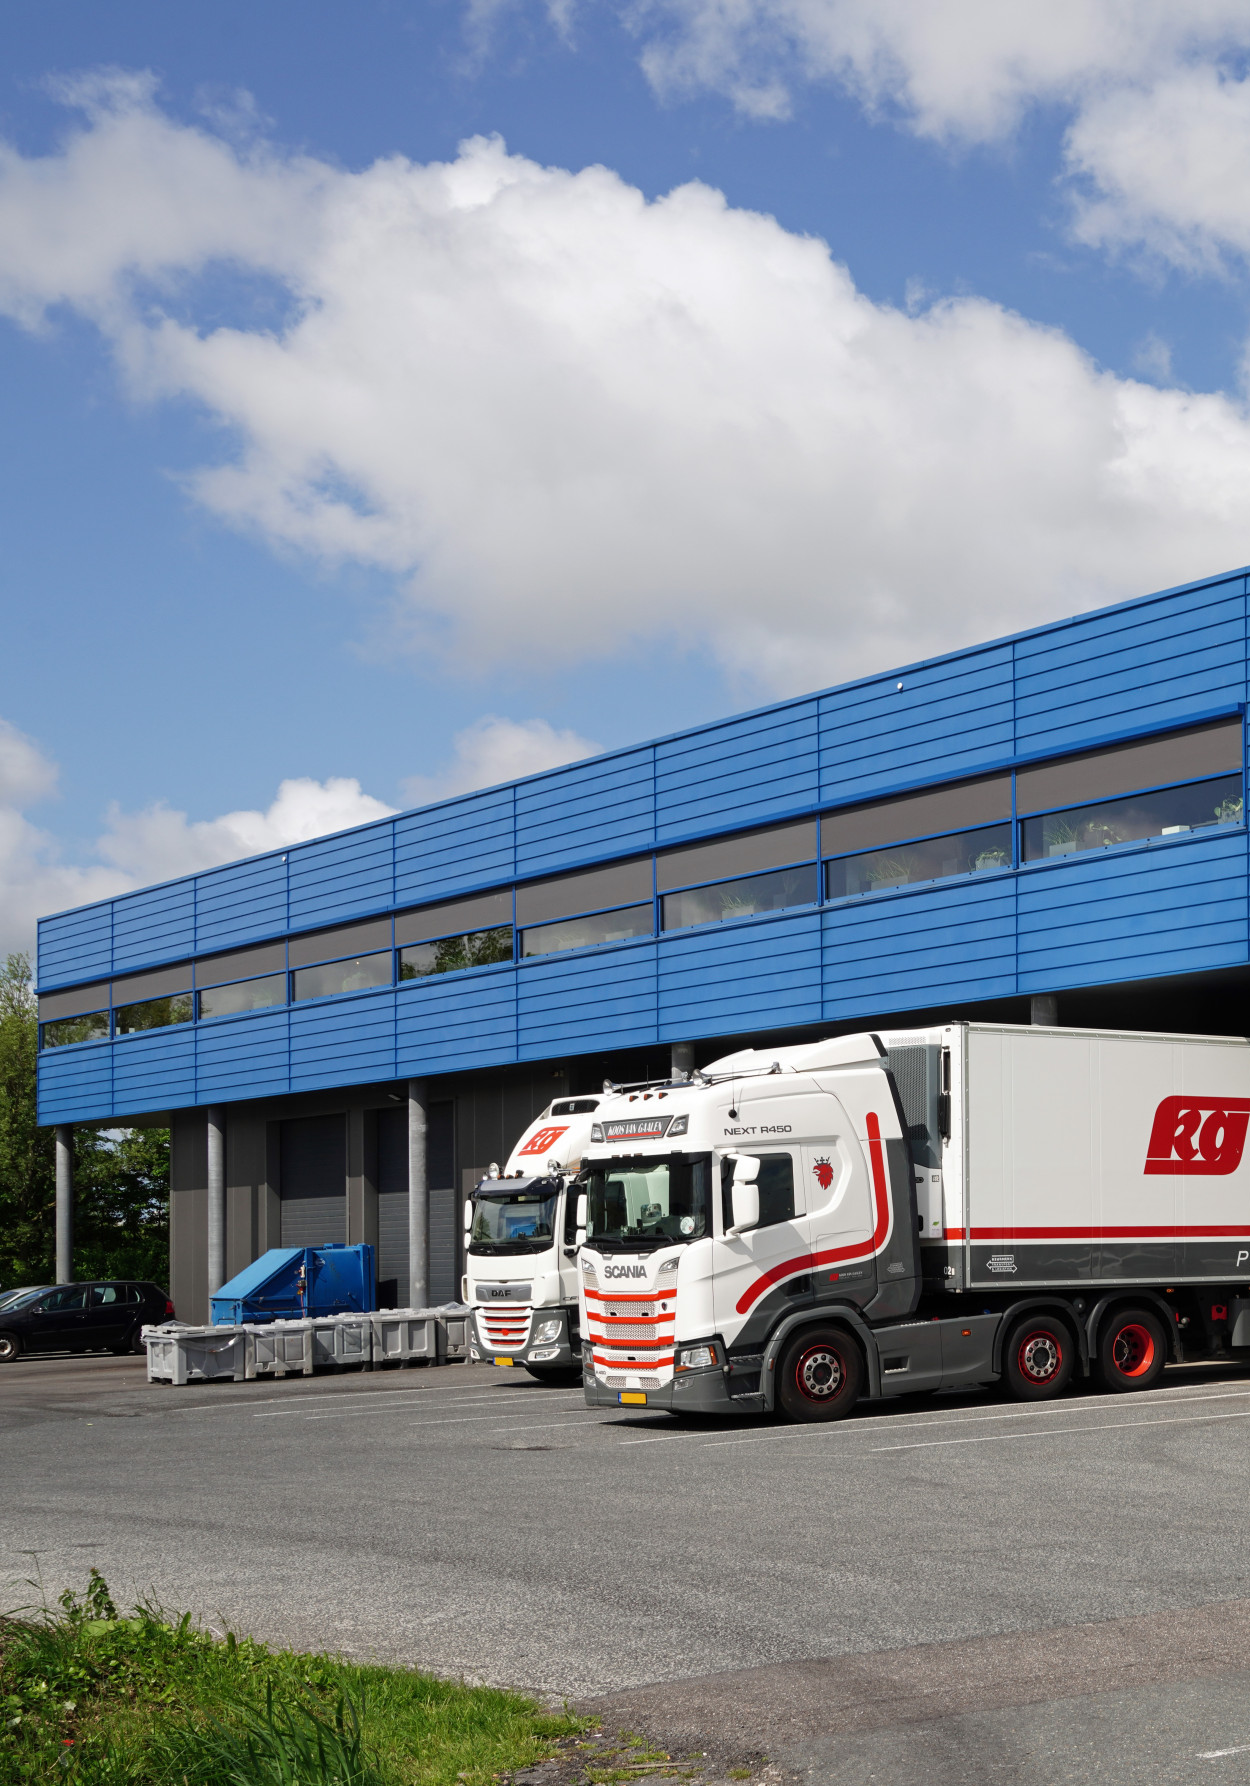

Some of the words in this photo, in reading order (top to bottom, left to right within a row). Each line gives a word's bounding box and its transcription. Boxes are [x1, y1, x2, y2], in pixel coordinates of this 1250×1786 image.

[607, 1125, 625, 1137] KOOS
[724, 1126, 757, 1136] NEXT
[760, 1125, 792, 1134] R450
[604, 1265, 648, 1279] SCANIA
[491, 1289, 512, 1297] DAF
